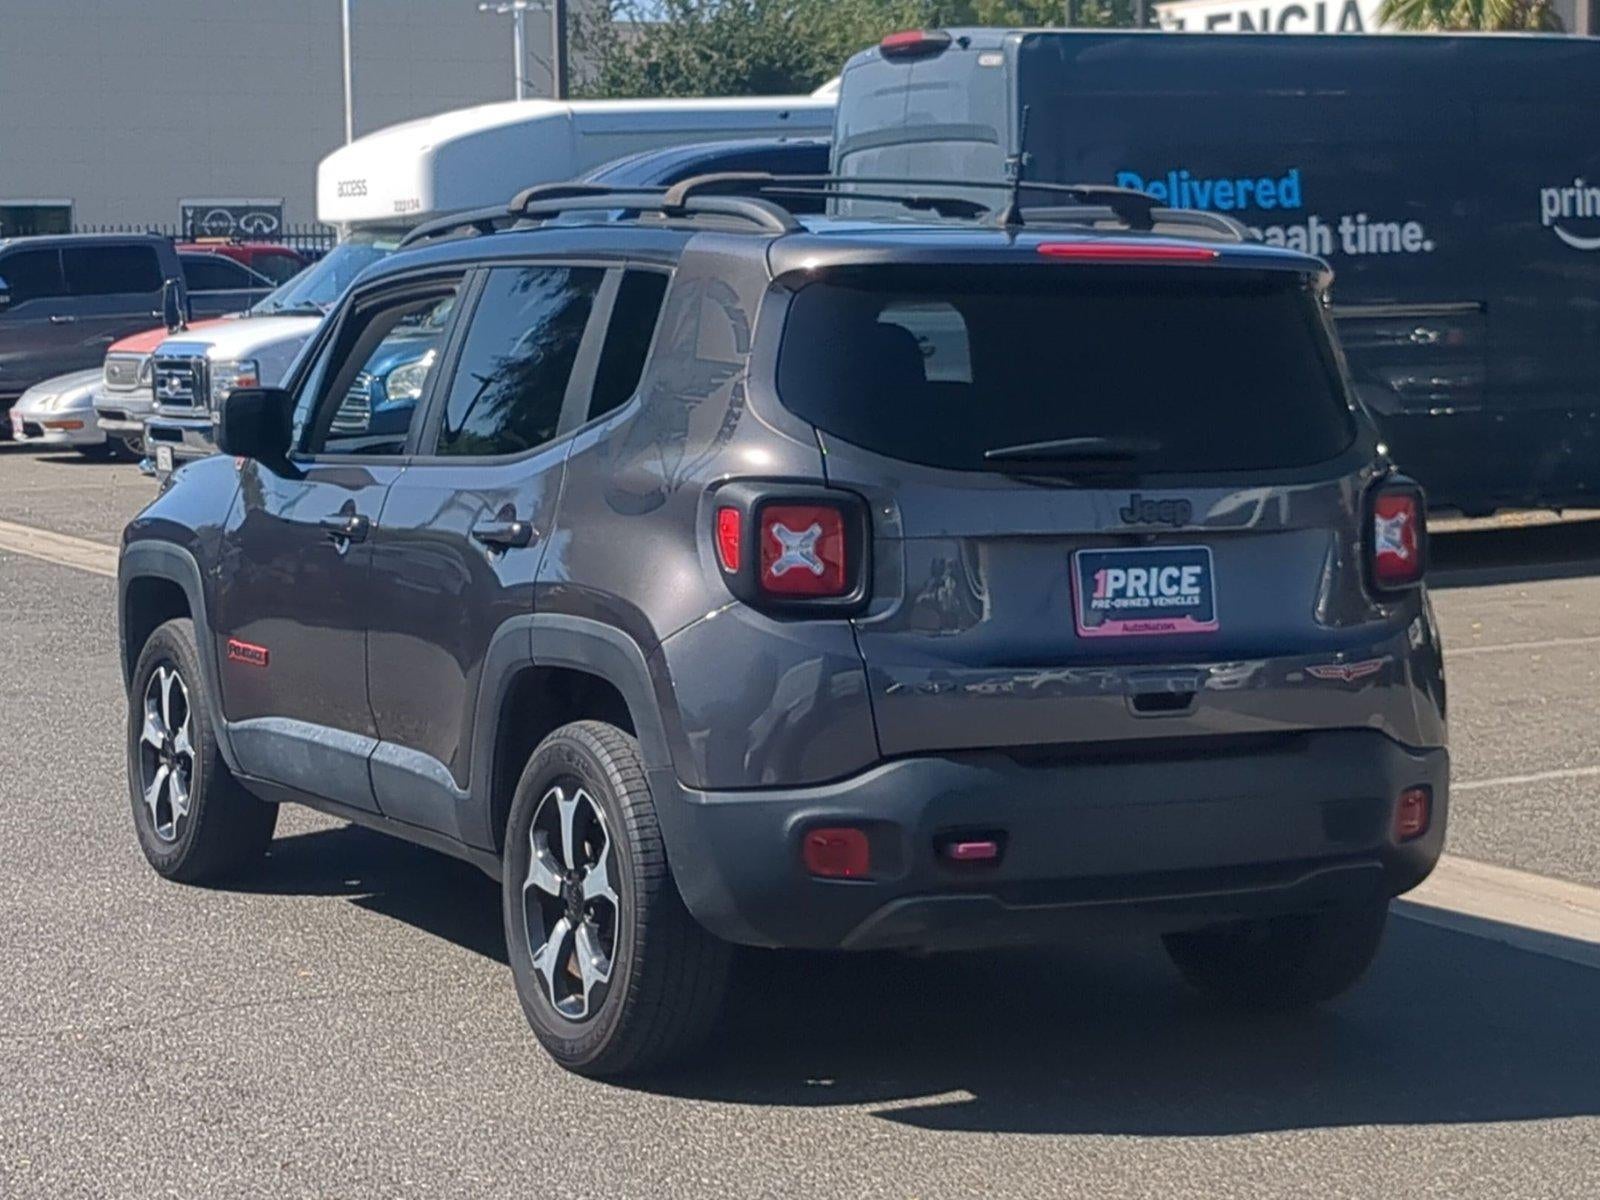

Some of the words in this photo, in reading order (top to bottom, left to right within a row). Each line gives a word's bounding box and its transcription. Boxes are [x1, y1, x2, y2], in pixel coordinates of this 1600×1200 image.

[1338, 213, 1436, 254] time.
[1119, 493, 1192, 528] Jeep
[1152, 595, 1200, 607] VEHICLES
